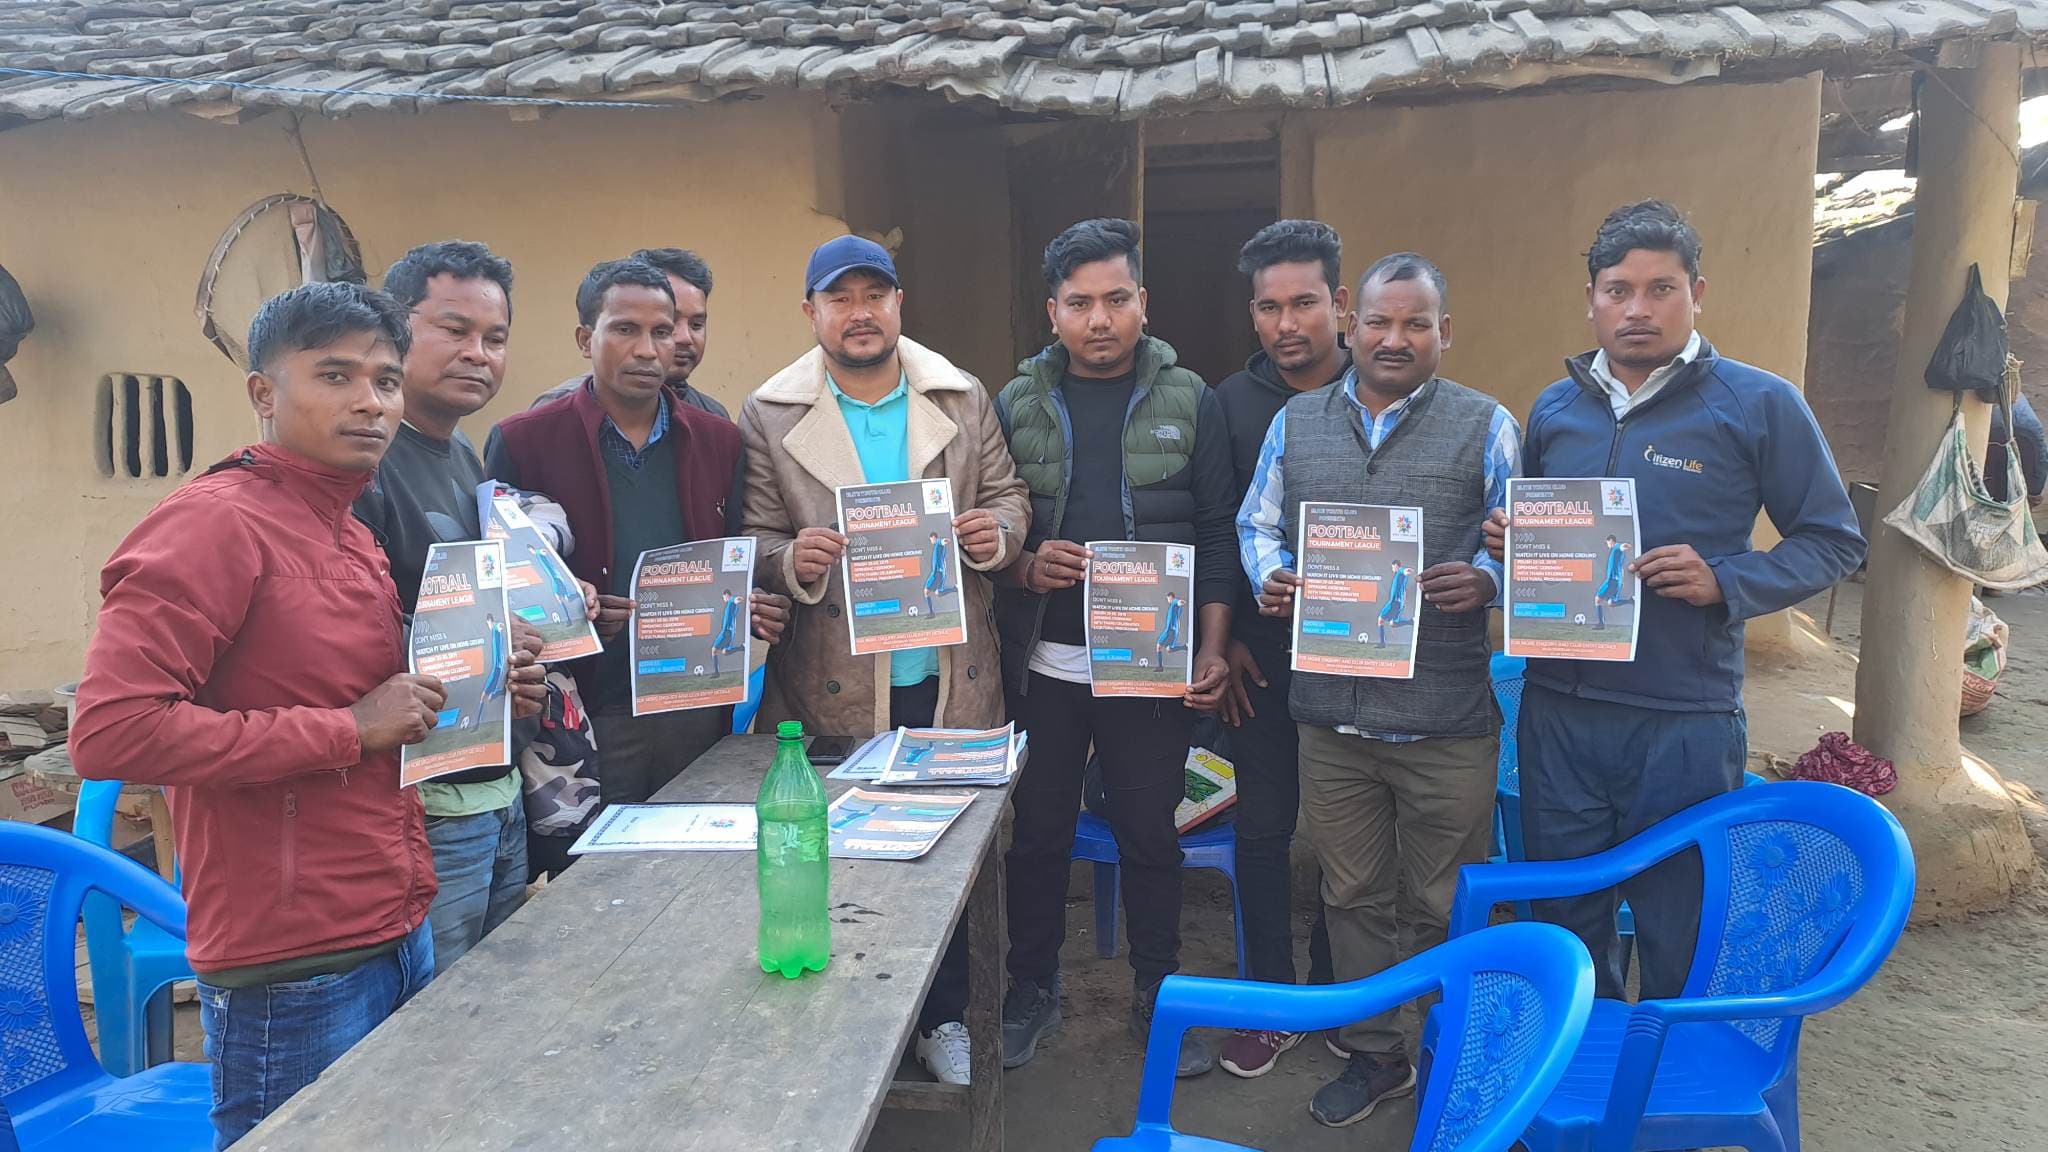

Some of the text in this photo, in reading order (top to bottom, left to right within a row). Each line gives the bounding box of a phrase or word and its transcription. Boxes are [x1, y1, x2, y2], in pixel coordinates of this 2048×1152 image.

[1644, 445, 1682, 467] Citizen
[1683, 458, 1703, 470] Life
[846, 503, 916, 521] FOOTBALL
[1514, 501, 1593, 516] FOOTBALL
[850, 521, 891, 530] TOURNAMENT
[1308, 524, 1381, 540] FOOTBALL
[1309, 540, 1354, 548] TOURNAMENT
[641, 560, 713, 577] FOOTBALL
[1093, 561, 1157, 574] FOOTBALL
[641, 577, 686, 585] TOURNAMENT
